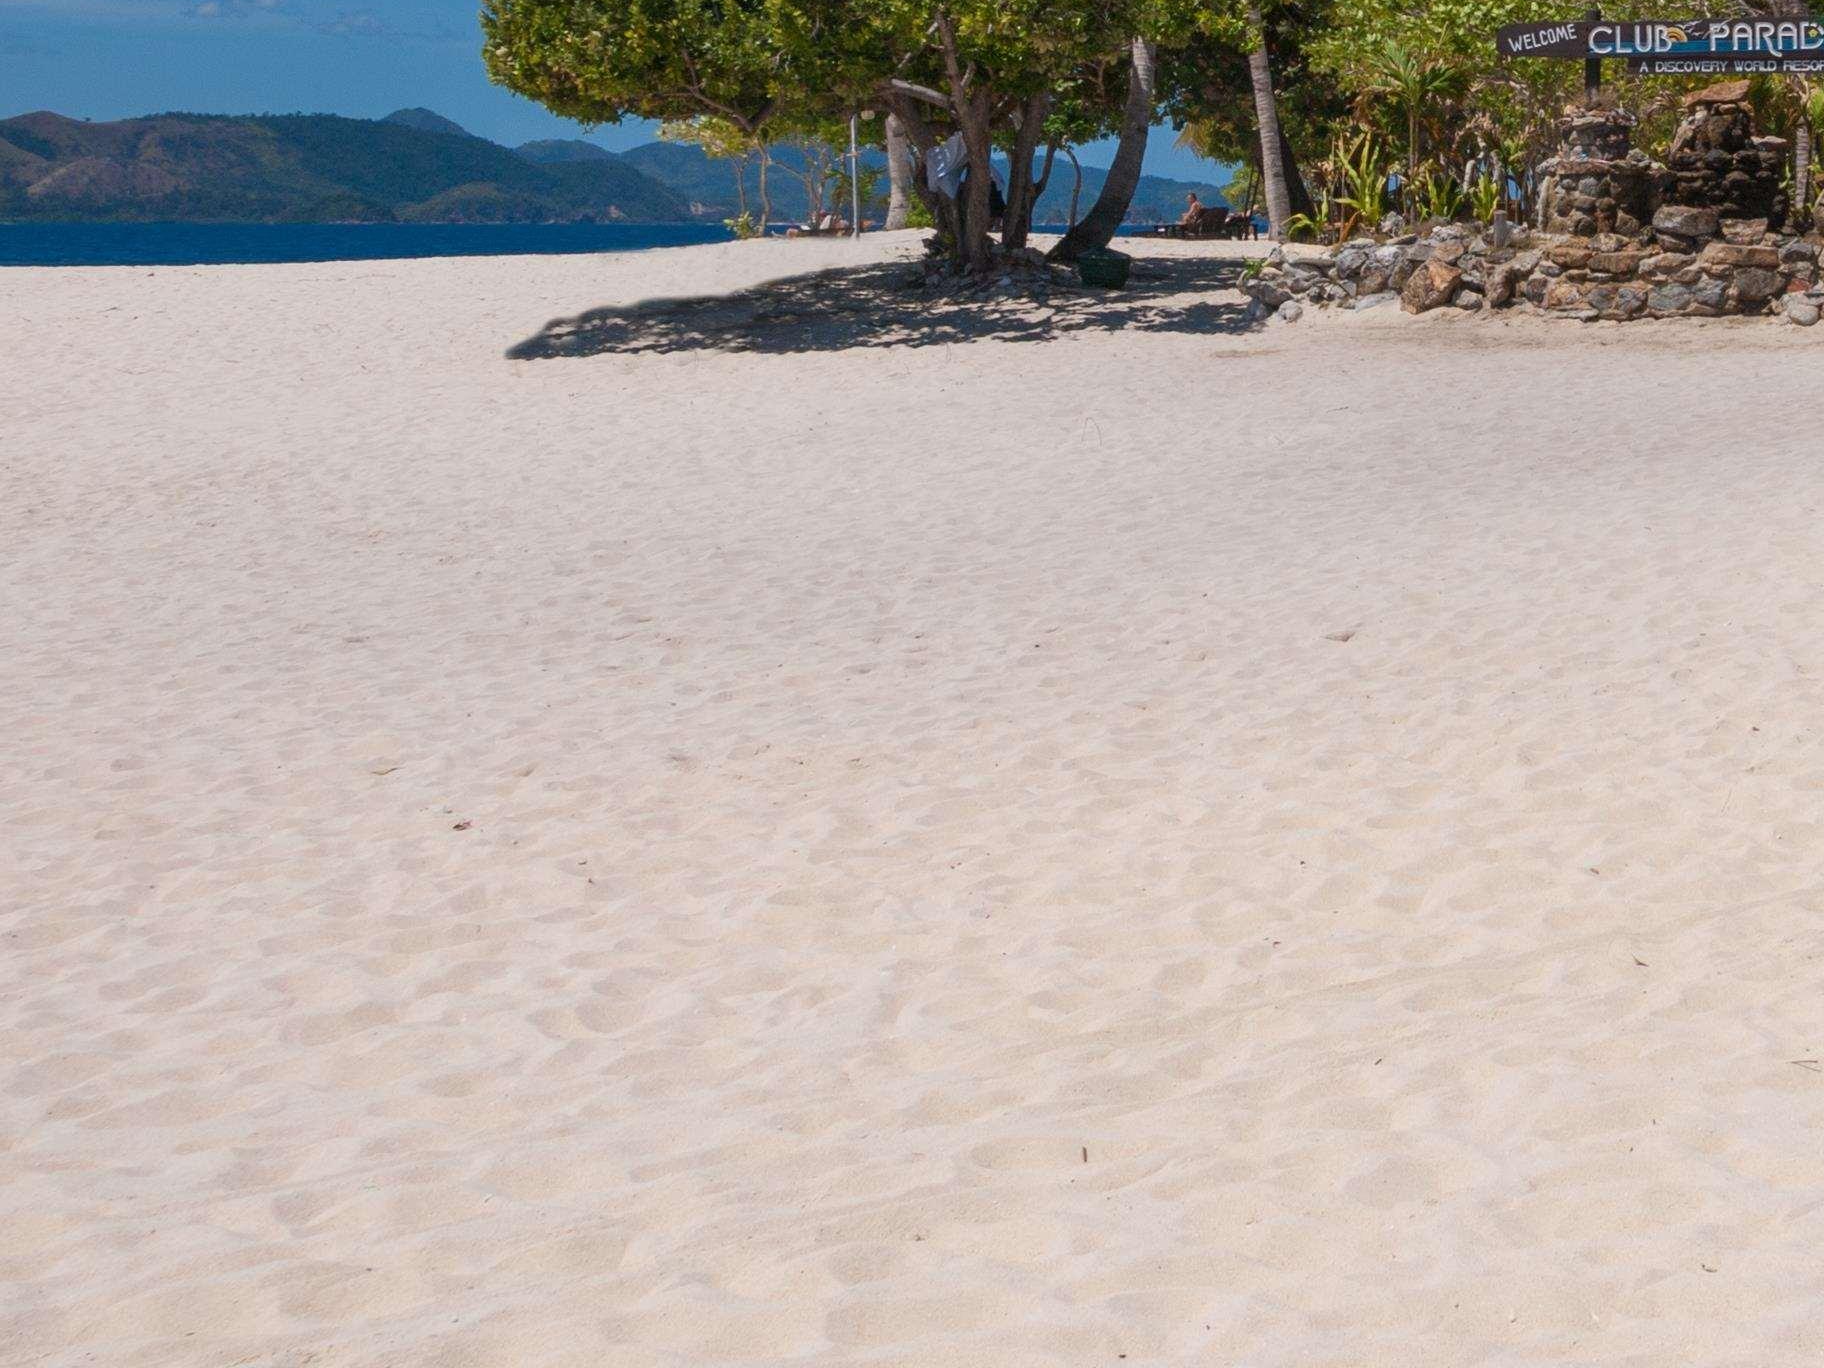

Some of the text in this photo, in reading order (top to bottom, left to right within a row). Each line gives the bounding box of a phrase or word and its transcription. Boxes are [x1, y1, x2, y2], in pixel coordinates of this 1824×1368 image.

[1508, 23, 1577, 53] WELCOME
[1588, 24, 1673, 54] CLUB
[1639, 62, 1649, 73] A
[1655, 60, 1728, 73] DISCOVERY
[1735, 59, 1777, 72] WORLD
